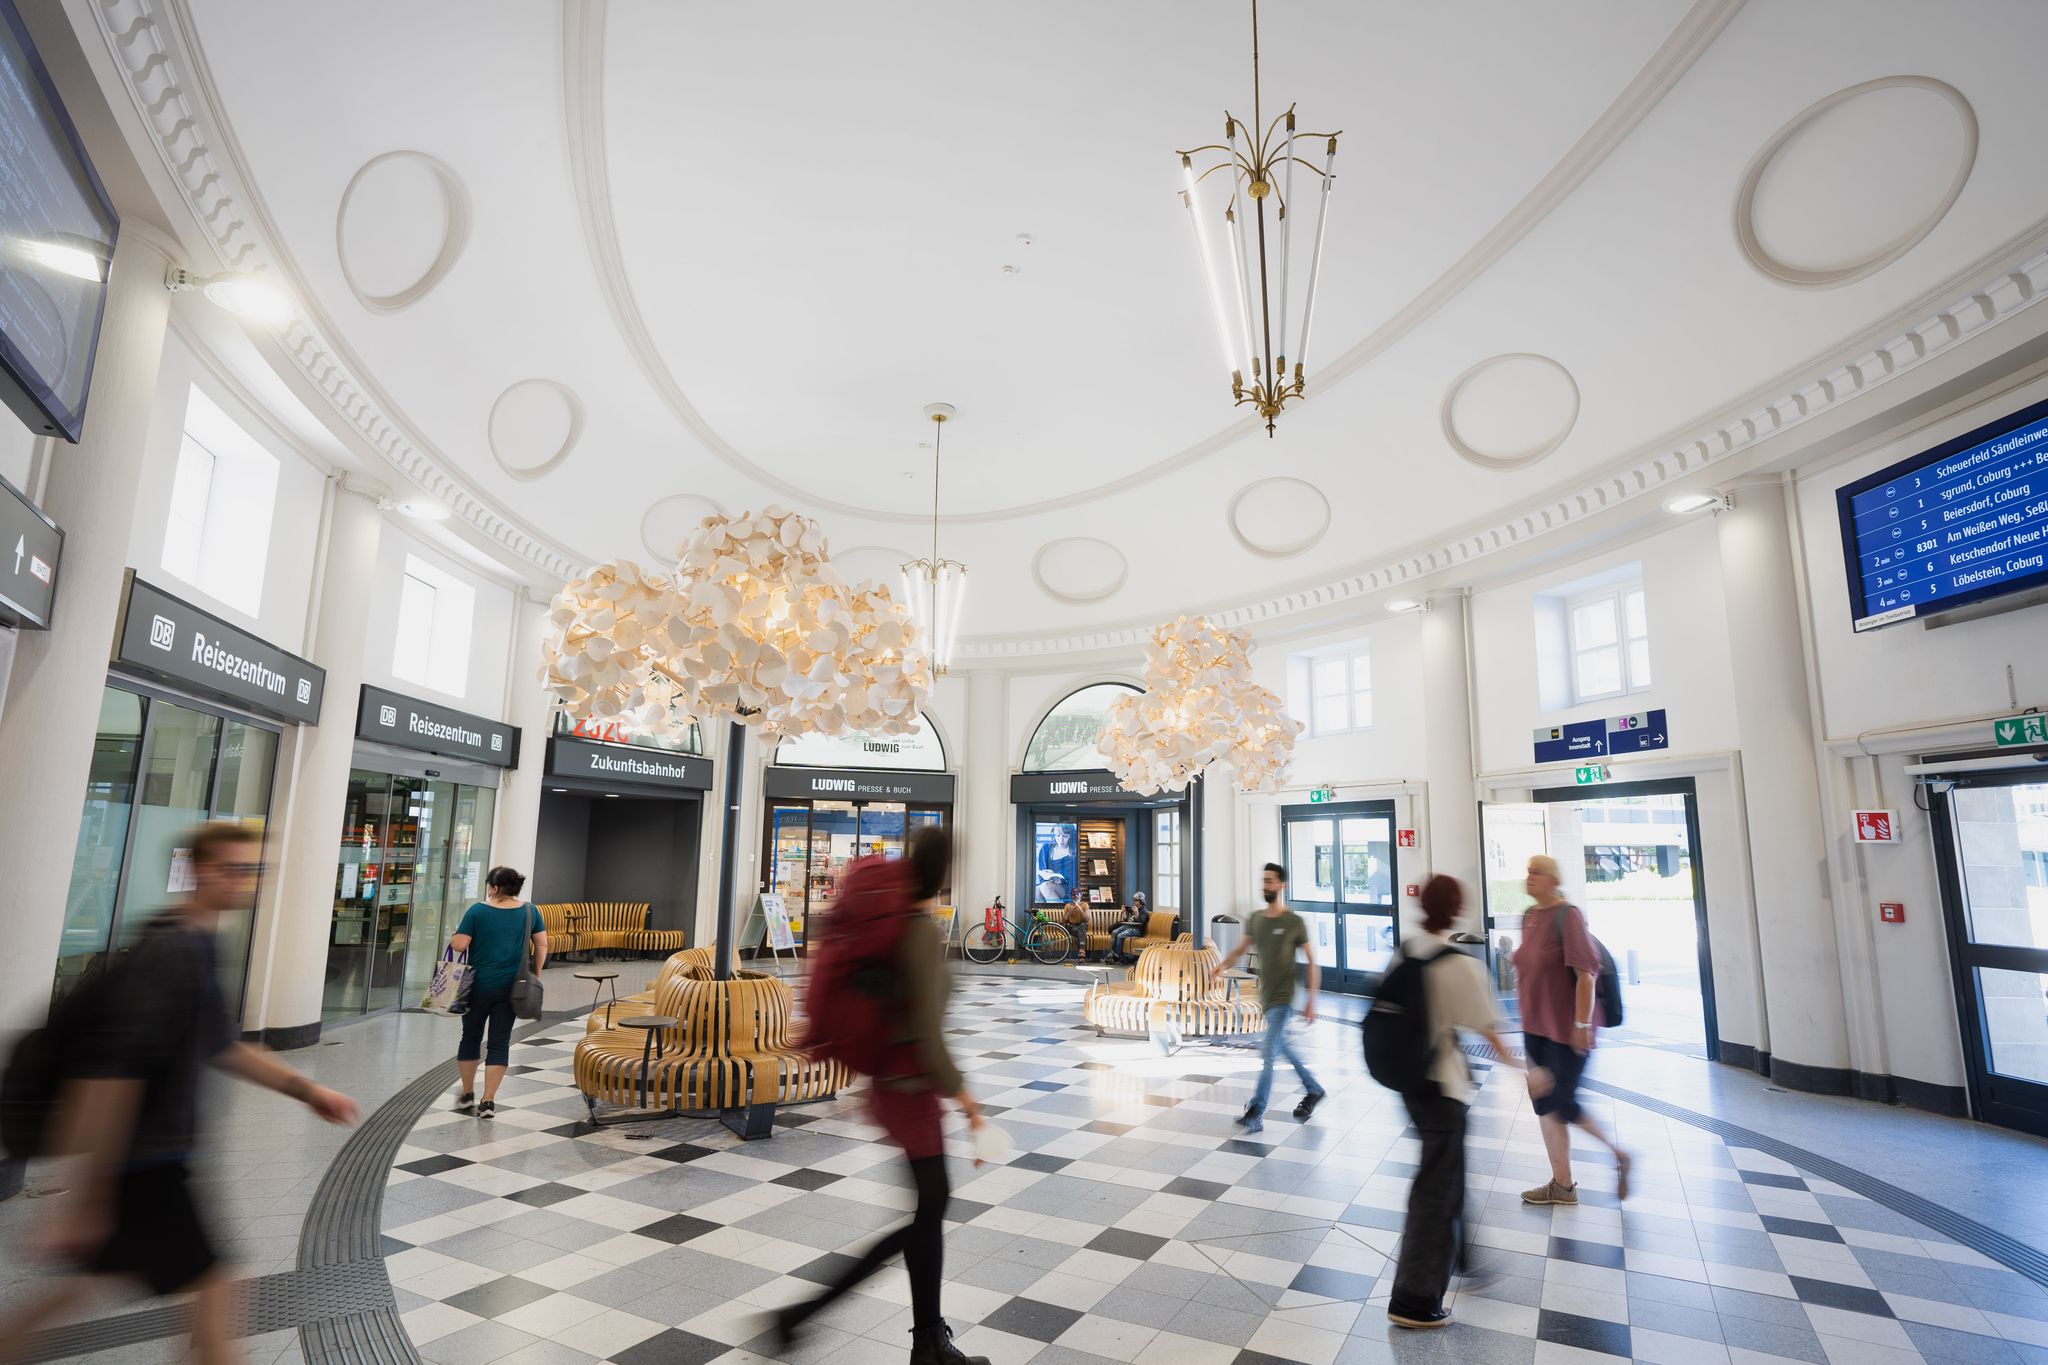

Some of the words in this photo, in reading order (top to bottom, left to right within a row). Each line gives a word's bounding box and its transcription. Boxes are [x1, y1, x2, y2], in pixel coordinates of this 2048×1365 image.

[1914, 477, 1921, 488] 3
[1936, 448, 1990, 479] Scheuerfeld
[1918, 498, 1924, 509] 1
[1940, 479, 1976, 500] sgrund,
[1976, 466, 2012, 486] Coburg
[2035, 452, 2048, 465] Be
[1921, 519, 1927, 530] 5
[1943, 495, 1993, 521] Beiersdorf,
[1994, 484, 2030, 503] Coburg
[1874, 556, 1880, 567] 2
[1916, 538, 1938, 553] 8301
[1947, 532, 1962, 543] Am
[1962, 520, 1998, 538] Weißen
[1998, 511, 2025, 526] Weg,
[1876, 577, 1883, 588] 3
[1927, 561, 1934, 572] 6
[1949, 536, 2012, 565] Ketschendorf
[2013, 530, 2040, 546] Neue
[1879, 597, 1886, 607] 4
[1930, 583, 1937, 594] 5
[1953, 565, 2005, 587] Löbelstein,
[2006, 554, 2043, 572] Coburg
[152, 618, 174, 648] DB
[192, 631, 286, 696] Reisezentrum
[298, 680, 310, 702] DB
[381, 707, 395, 726] DB
[409, 712, 482, 747] Reisezentrum
[492, 735, 502, 750] DB
[863, 742, 900, 753] LUDWIG
[590, 754, 686, 779] Zukunftsbahnhof
[811, 778, 856, 792] LUDWIG
[858, 785, 883, 793] PRESSE
[1050, 781, 1088, 794] LUDWIG
